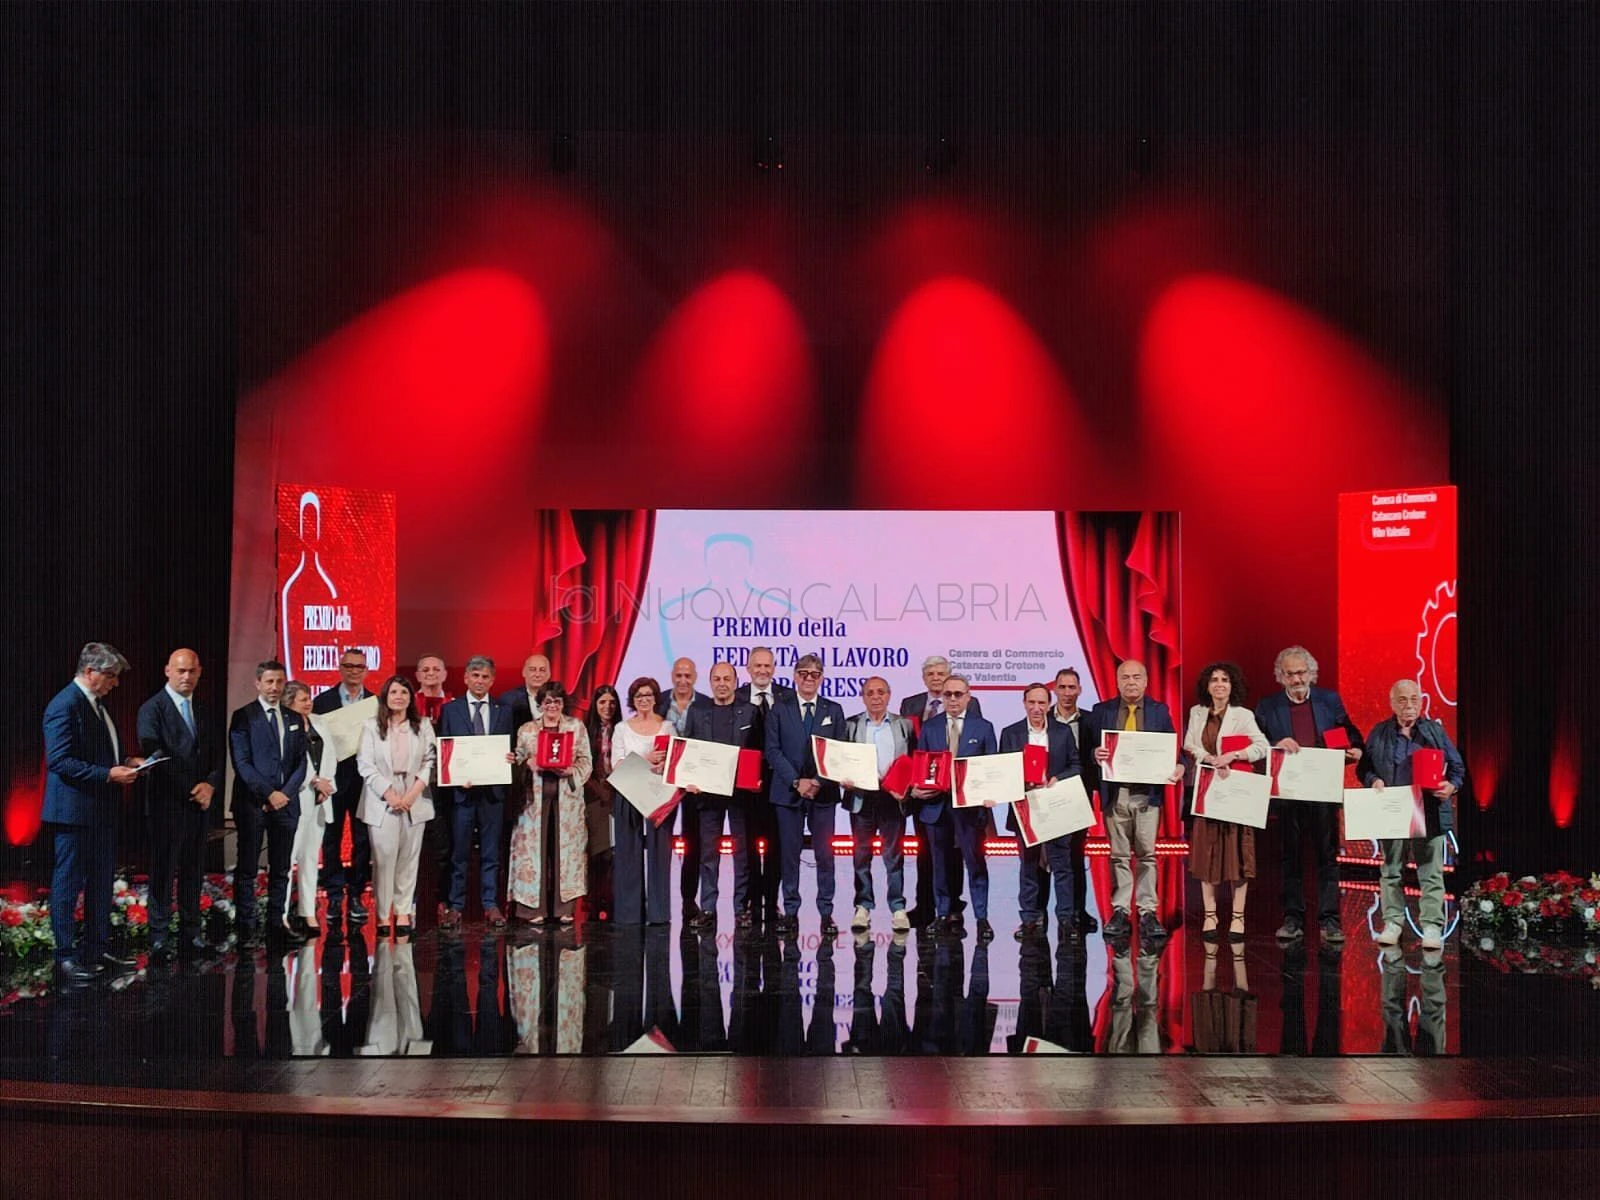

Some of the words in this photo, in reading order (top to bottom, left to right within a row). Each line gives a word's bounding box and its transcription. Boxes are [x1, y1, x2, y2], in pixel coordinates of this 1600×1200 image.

[304, 605, 335, 631] PREMIO
[335, 605, 352, 631] della
[712, 617, 791, 637] PREMIO
[799, 617, 846, 637] della
[304, 639, 340, 670] FEDELTÀ
[832, 647, 908, 667] LAVORO
[949, 649, 989, 658] Camera
[992, 649, 1002, 658] di
[1005, 649, 1064, 658] Commercio
[951, 661, 1002, 670] Catanzaro
[1005, 661, 1046, 670] Crotone
[974, 673, 1017, 682] Valentia
